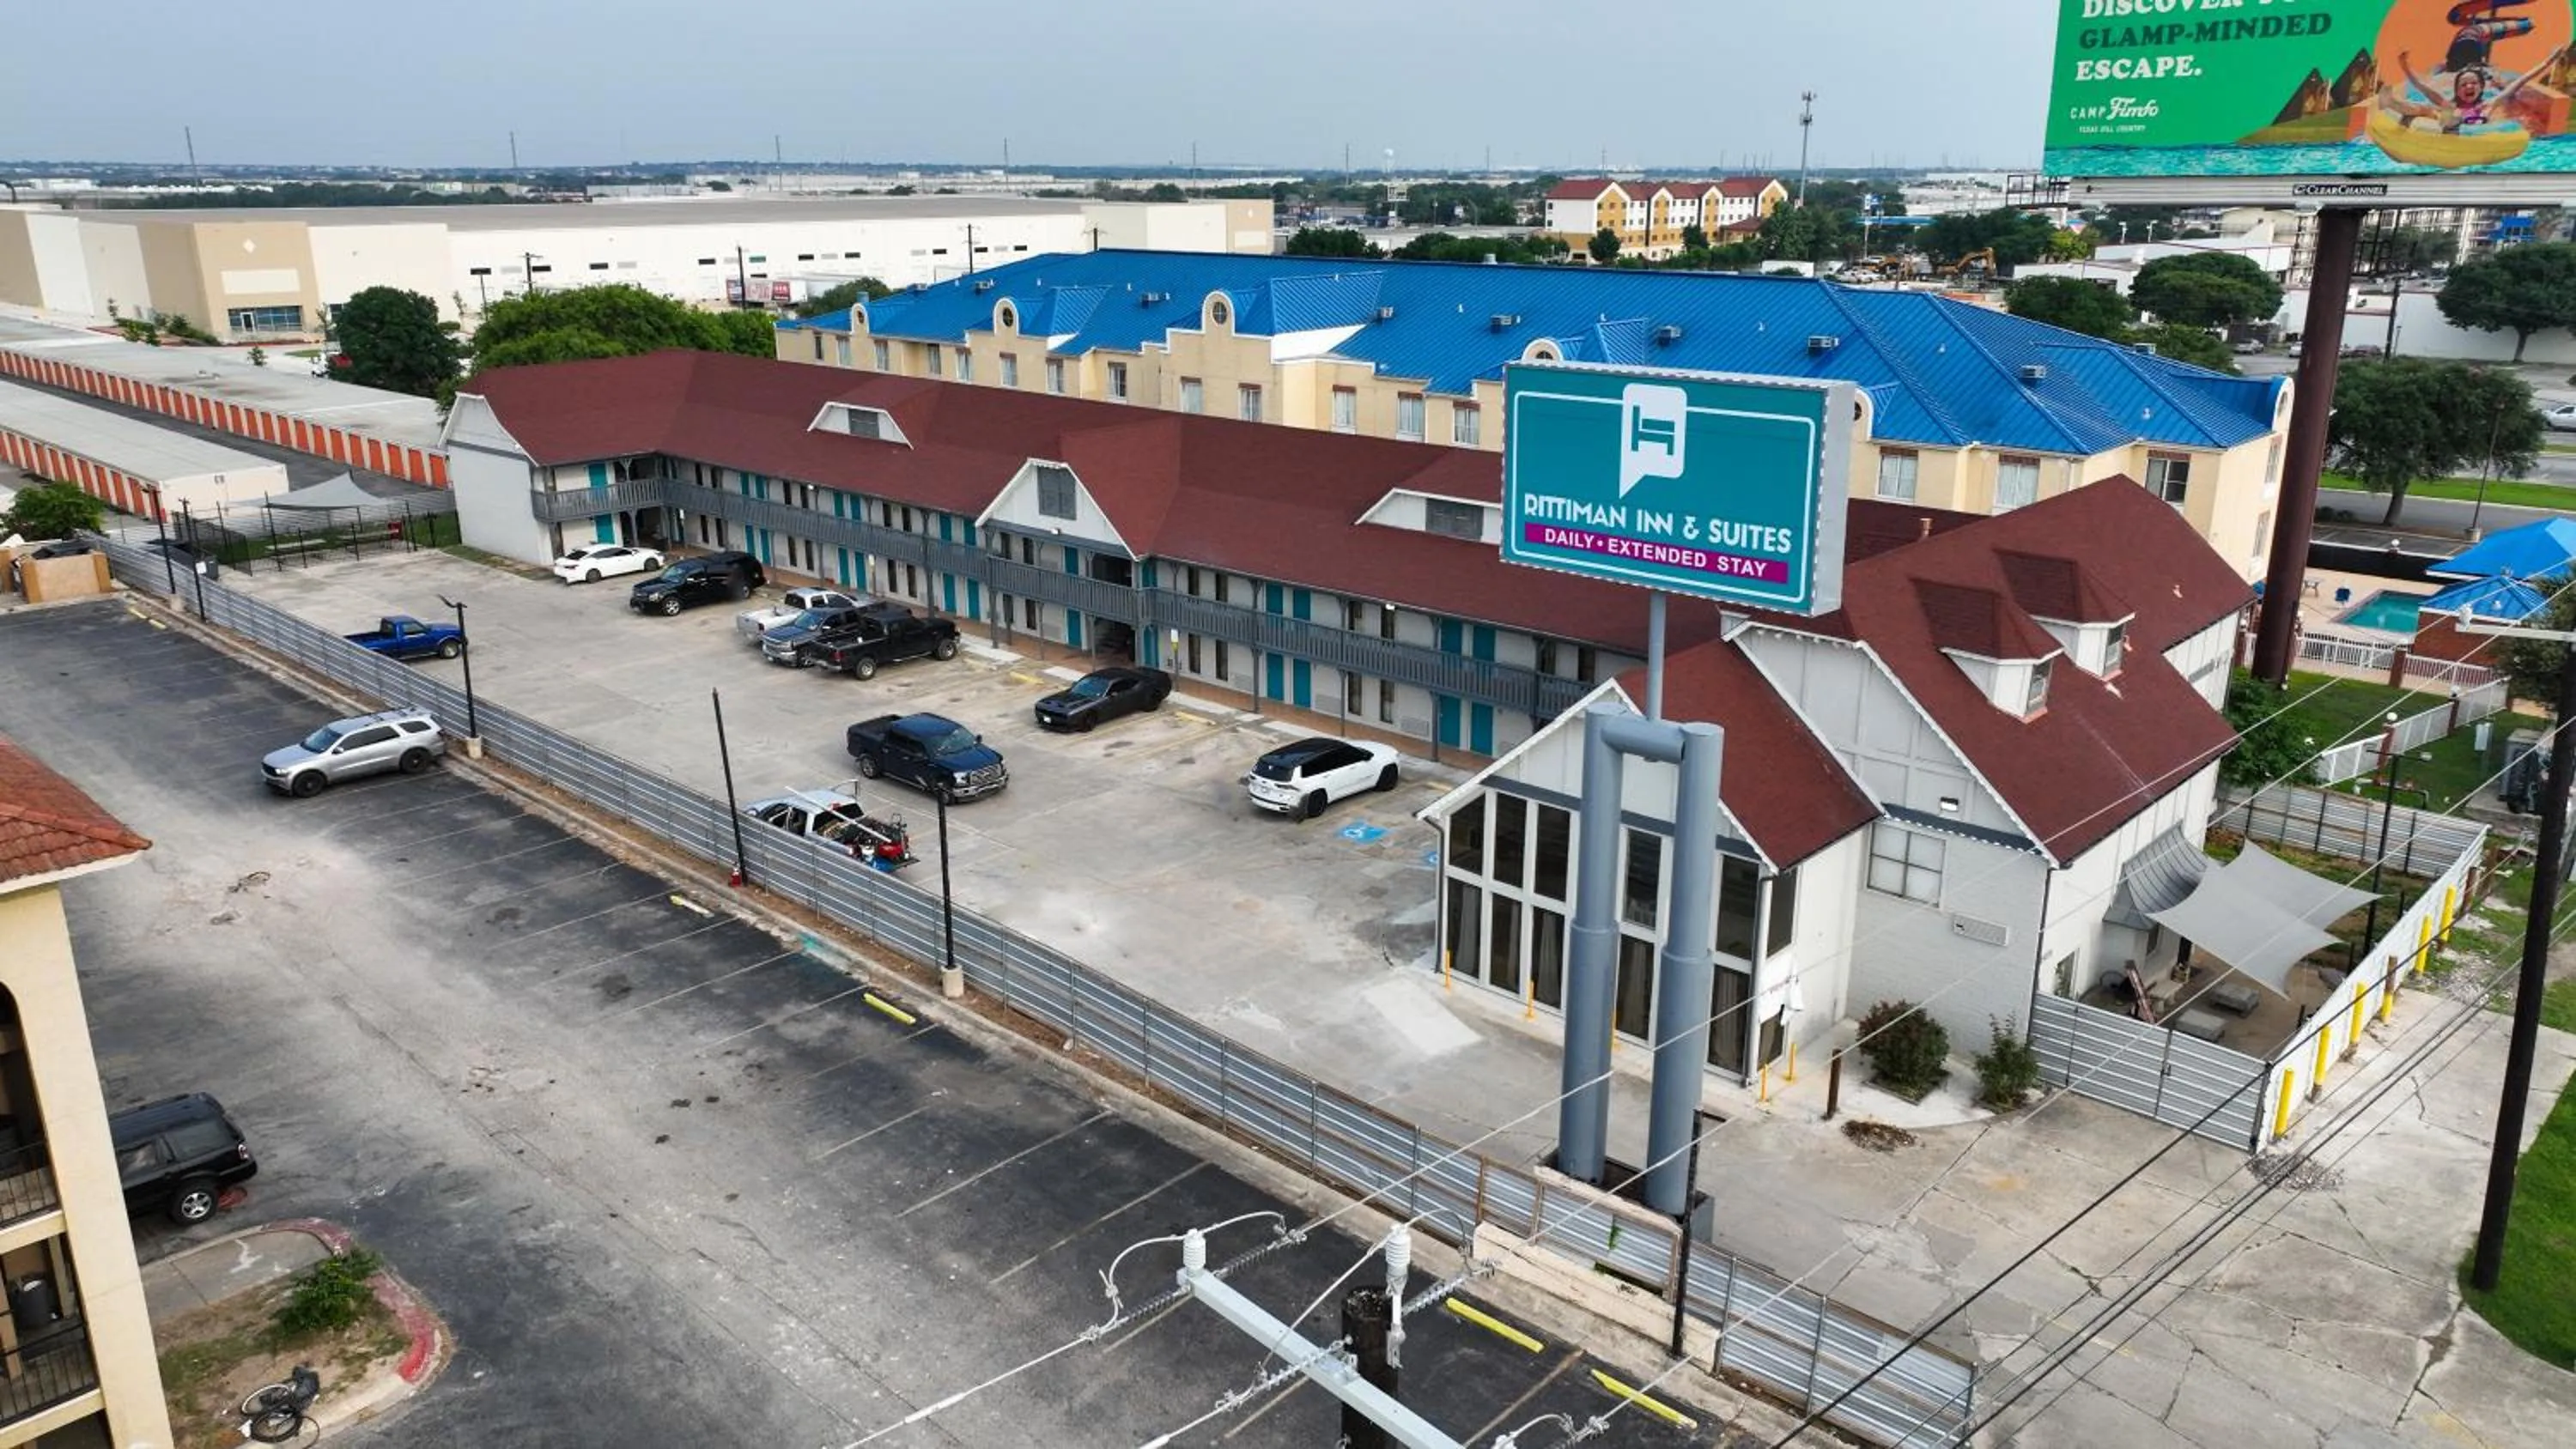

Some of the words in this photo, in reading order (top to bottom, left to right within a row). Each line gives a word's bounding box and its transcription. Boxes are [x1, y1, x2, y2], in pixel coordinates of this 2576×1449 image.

[2079, 13, 2332, 49] GLAMP-MINDED
[2075, 55, 2202, 81] ESCAPE.
[2070, 106, 2106, 119] CAMP
[1524, 493, 1626, 529] RITTIMAN
[1637, 508, 1674, 537] INN
[1682, 515, 1700, 540] &
[1709, 518, 1792, 554] SUITES
[1545, 528, 1595, 549] DAILY
[1607, 538, 1707, 567] EXTENDED
[1717, 555, 1767, 577] STAY
